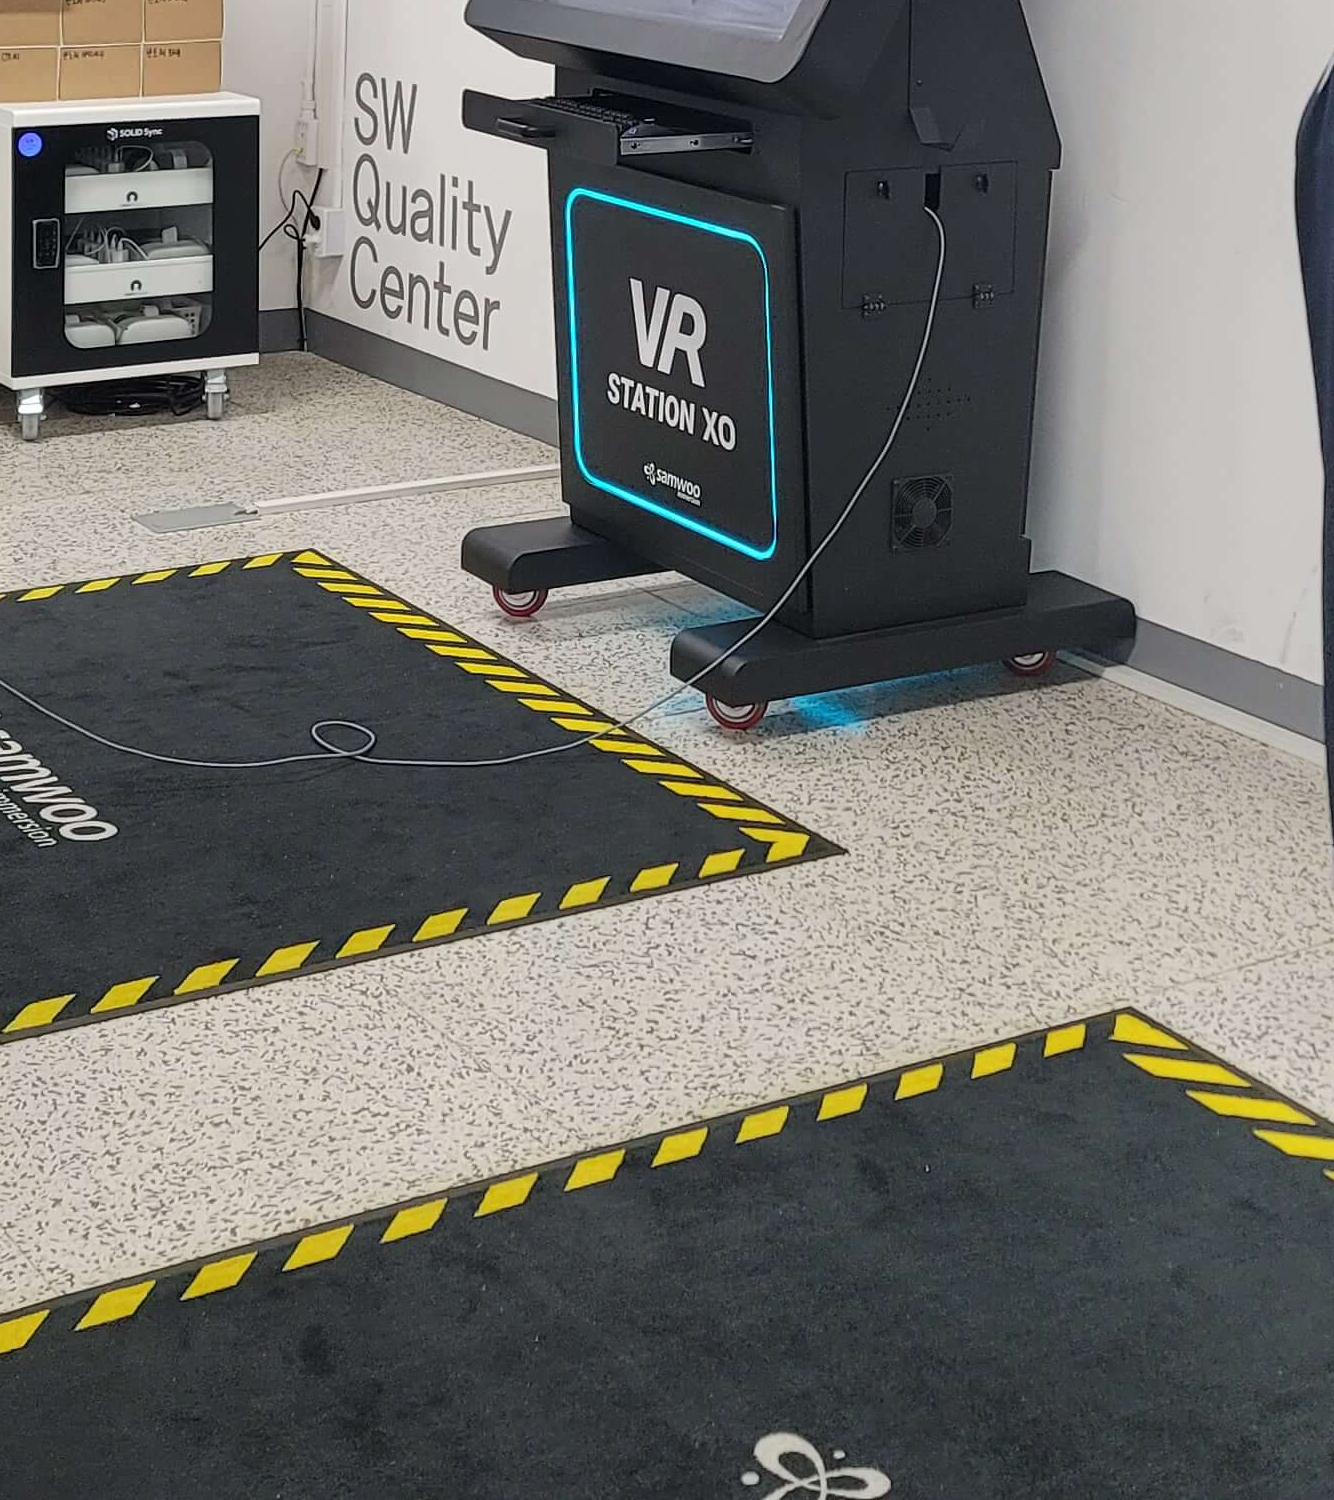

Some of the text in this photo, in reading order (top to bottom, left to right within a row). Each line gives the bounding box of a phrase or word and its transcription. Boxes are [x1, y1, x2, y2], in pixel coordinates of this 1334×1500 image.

[119, 127, 163, 138] SOLID Sync
[354, 72, 417, 154] SW
[353, 153, 512, 275] Quality
[350, 236, 500, 350] Center
[629, 277, 706, 388] VR
[607, 373, 736, 451] STATION XO
[656, 468, 701, 498] samwoo
